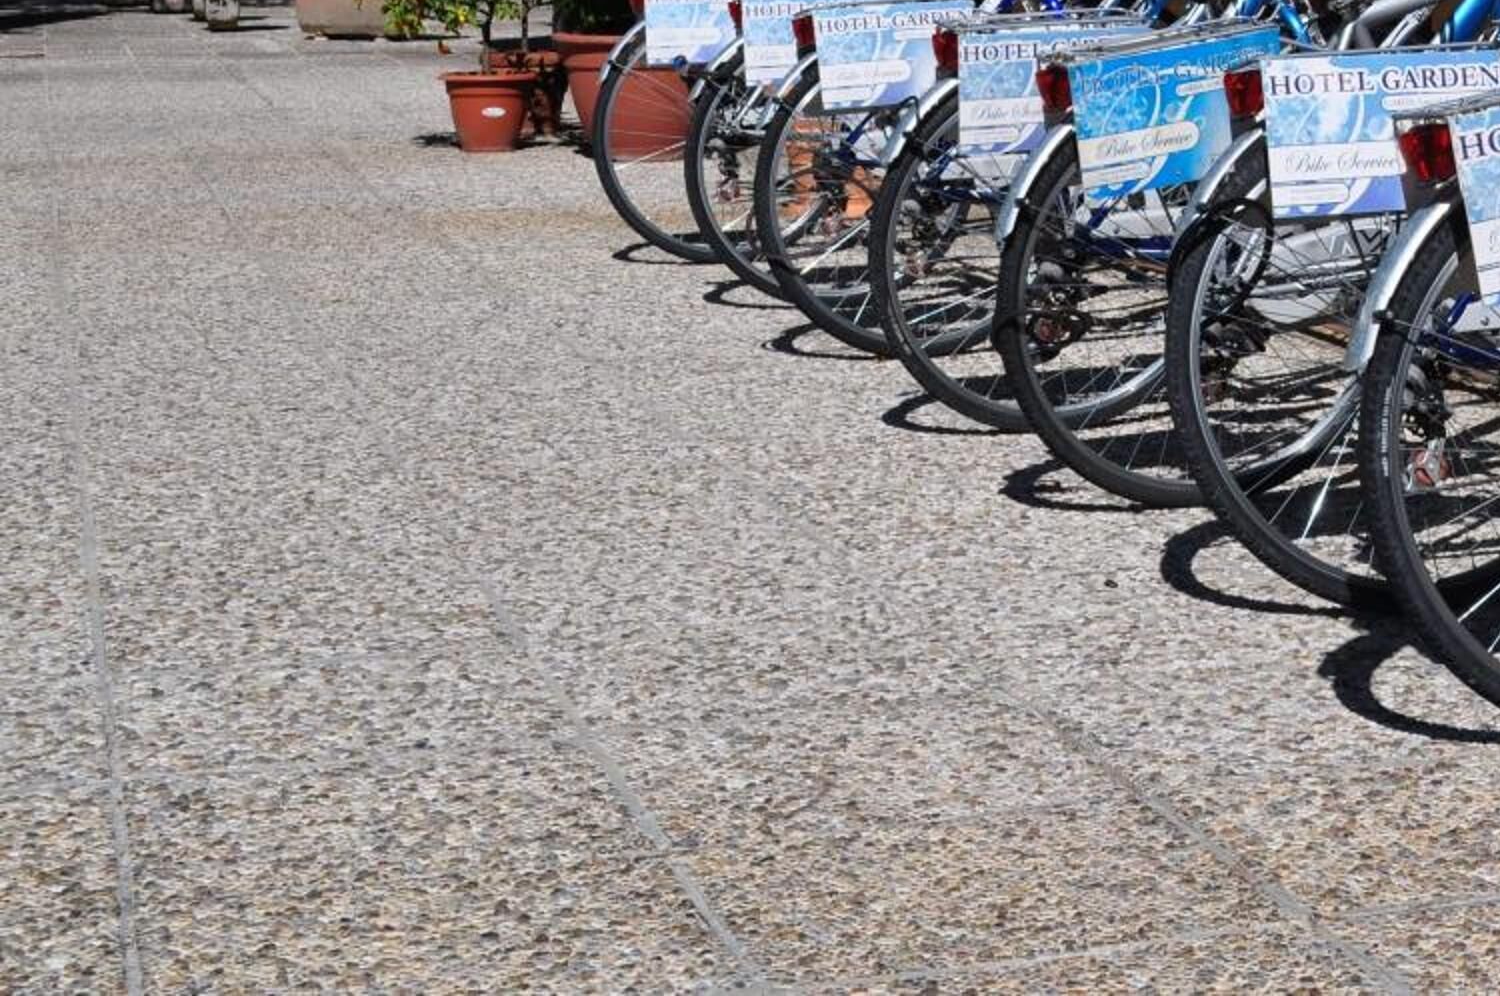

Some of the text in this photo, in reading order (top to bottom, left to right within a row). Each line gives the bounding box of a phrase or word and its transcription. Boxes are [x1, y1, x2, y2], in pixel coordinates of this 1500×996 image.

[819, 17, 887, 33] HOTEL
[962, 42, 1046, 62] HOTEL
[1270, 65, 1500, 96] HOTEL GARDEN
[1286, 152, 1329, 173] Bike
